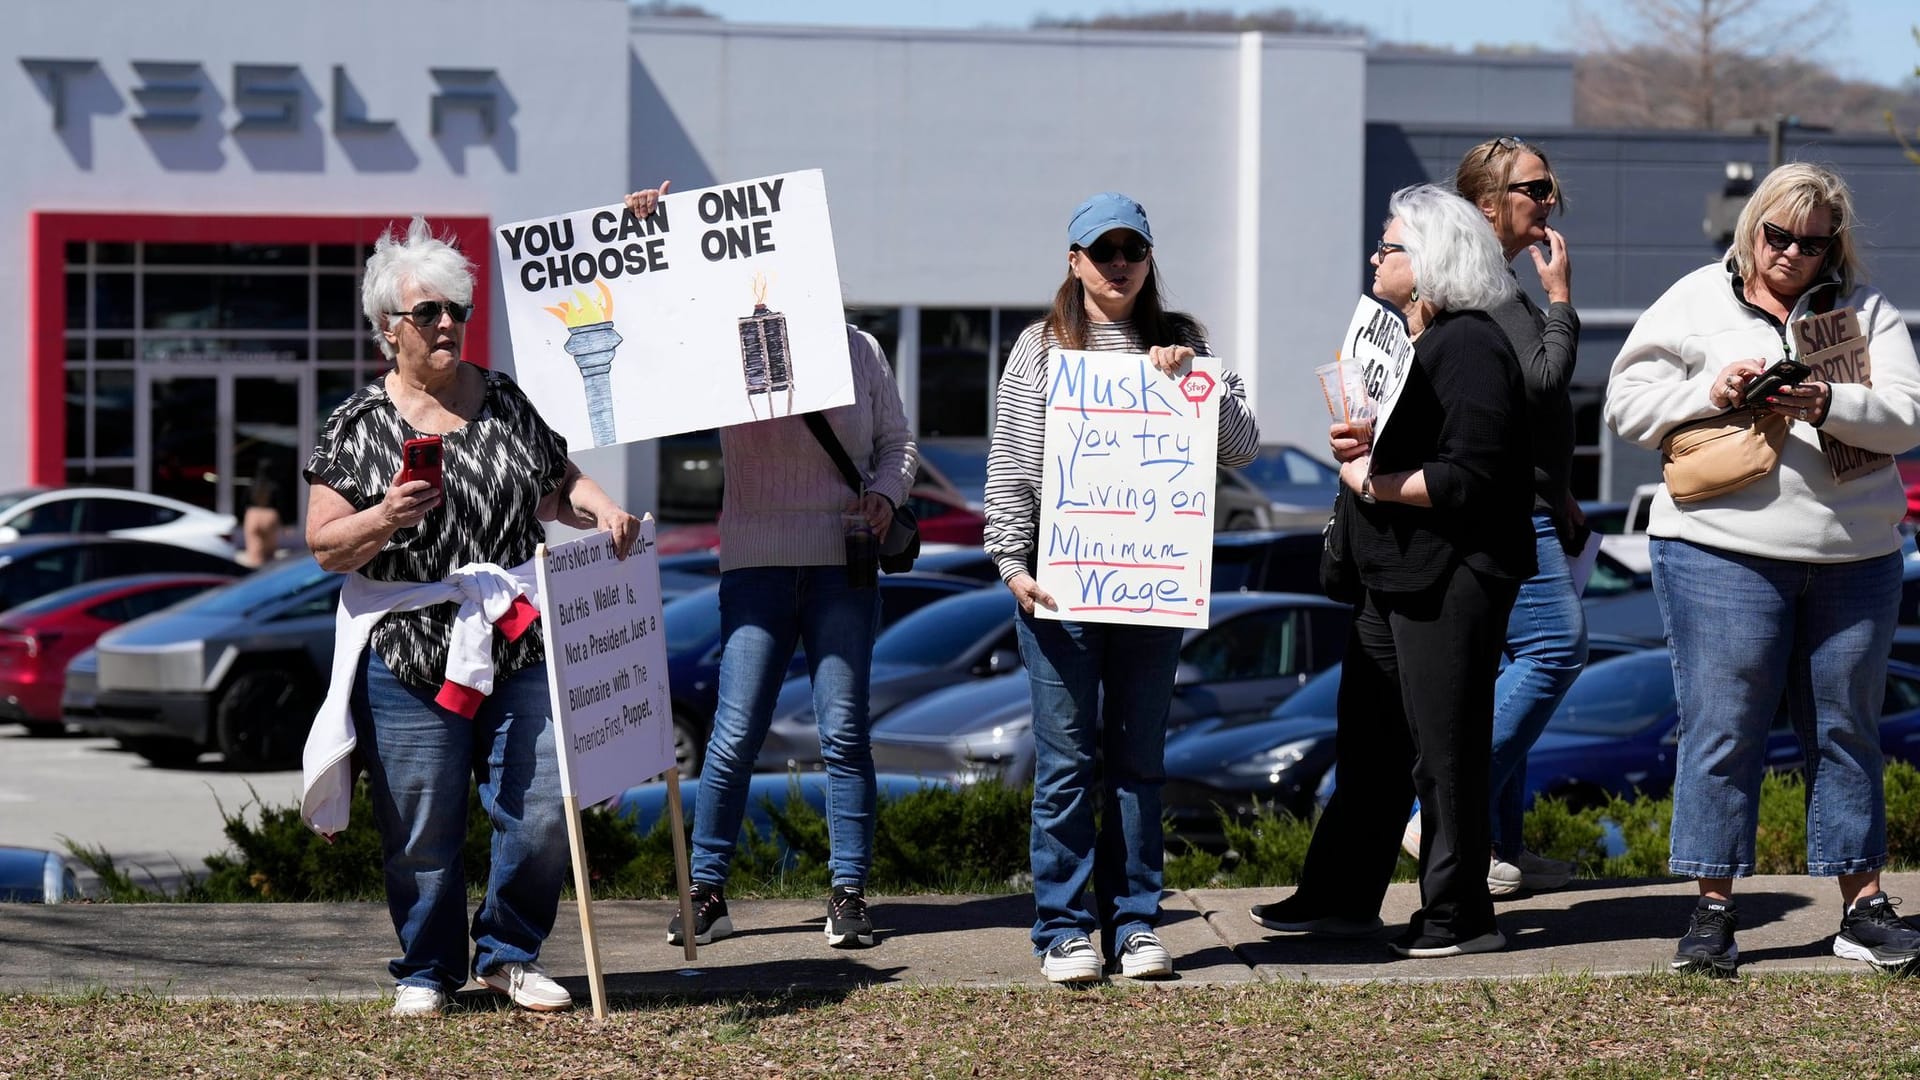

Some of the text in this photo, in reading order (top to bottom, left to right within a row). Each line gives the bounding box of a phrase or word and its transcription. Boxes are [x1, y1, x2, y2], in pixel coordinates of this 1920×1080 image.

[17, 58, 498, 138] TESLA
[500, 178, 784, 261] YOU CAN ONLY
[520, 220, 775, 292] CHOOSE ONE
[1800, 311, 1853, 354] SAVE
[1047, 354, 1183, 420] Musk
[1186, 382, 1207, 394] Stop
[1068, 418, 1195, 489] you try
[1056, 455, 1207, 523] Living on
[573, 545, 590, 568] Not
[591, 545, 602, 565] on
[1048, 522, 1189, 573] Minimum
[559, 583, 637, 626] But His Wallet Is.
[565, 615, 656, 665] Not a President. Just a
[569, 664, 648, 711] Billionaire with The
[573, 726, 606, 754] America
[622, 698, 653, 728] Puppet.
